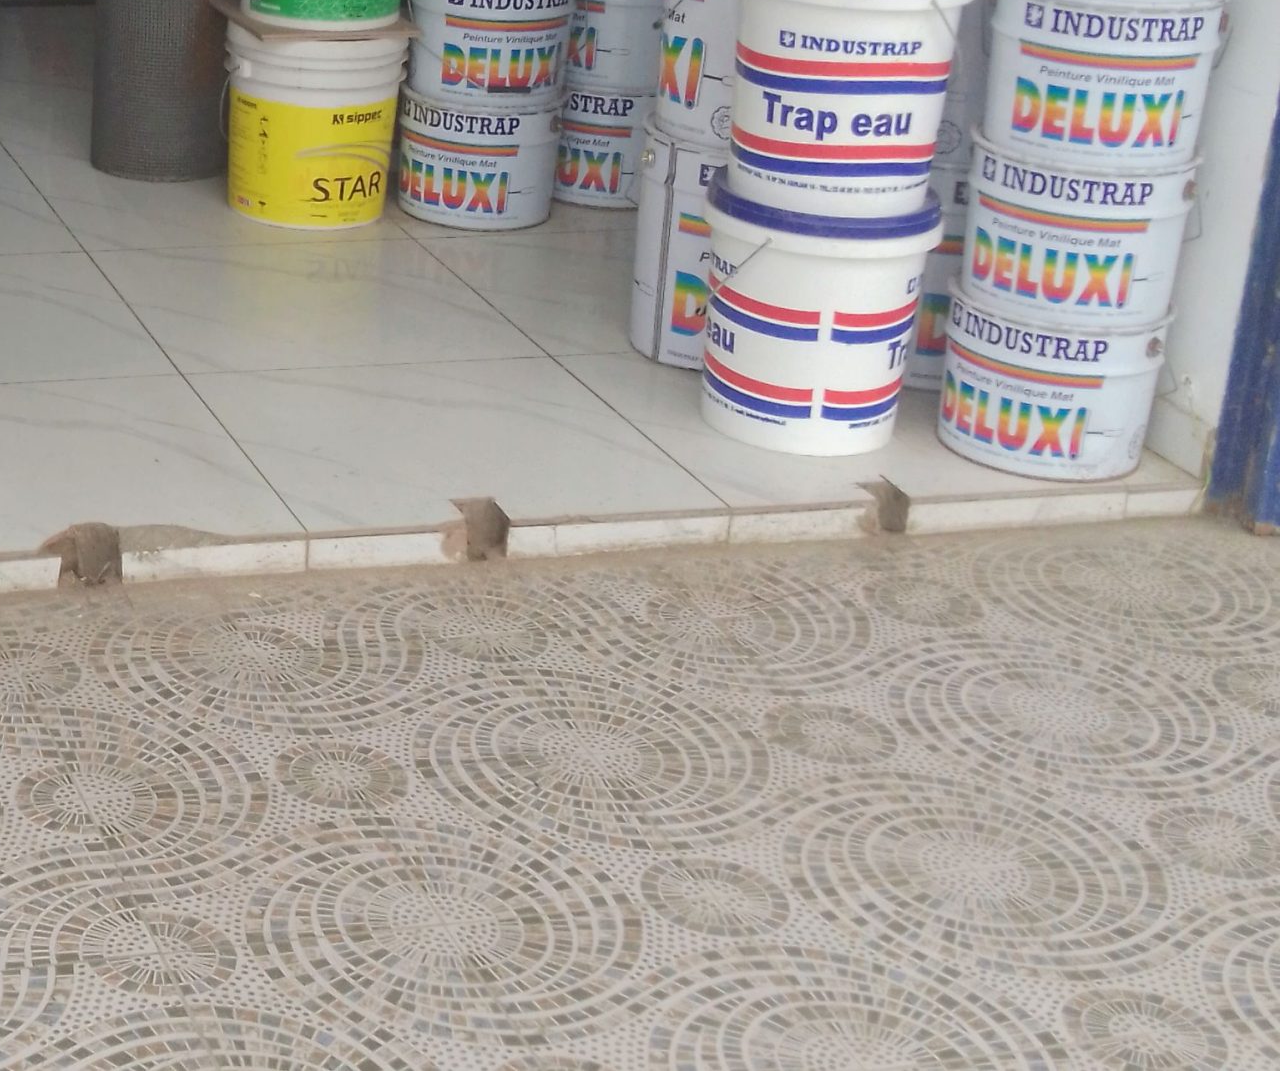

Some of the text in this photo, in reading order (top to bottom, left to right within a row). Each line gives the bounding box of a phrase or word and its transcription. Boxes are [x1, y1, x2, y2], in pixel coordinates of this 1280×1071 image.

[463, 32, 503, 44] Peinture
[1052, 8, 1205, 43] INDUSTRAP
[801, 34, 922, 56] INDUSTRAP
[1039, 65, 1175, 88] Peinture Vinilique Mat
[346, 109, 382, 125] sippec
[413, 102, 520, 137] INDUSTRAP
[762, 90, 913, 141] Trap eau
[593, 137, 610, 148] Mat
[479, 157, 498, 169] Mat
[311, 170, 382, 203] STAR
[1001, 163, 1154, 207] INDUSTRAP
[991, 216, 1122, 249] Peinture Vinilique Mat
[965, 311, 1109, 363] INDUSTRAP
[956, 361, 1075, 403] Peinture Vinilique Mat
